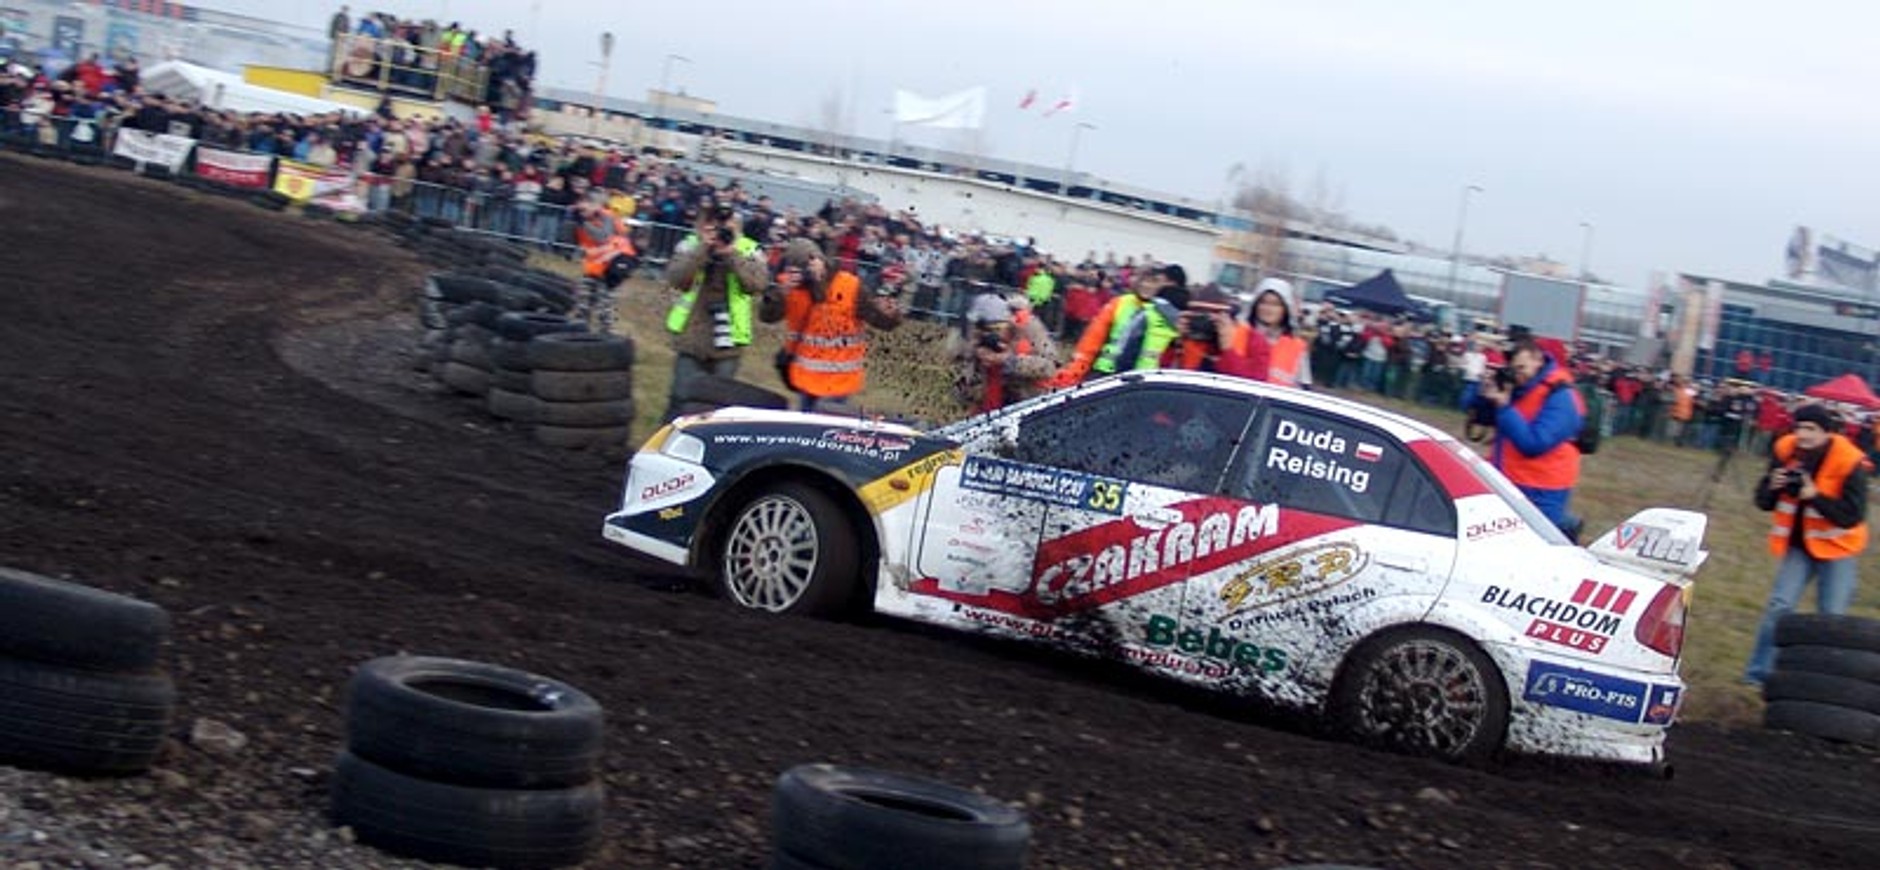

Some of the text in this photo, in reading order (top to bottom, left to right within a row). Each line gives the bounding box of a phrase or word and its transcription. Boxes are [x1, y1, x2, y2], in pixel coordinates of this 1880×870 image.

[1276, 420, 1346, 454] Duda
[1266, 447, 1370, 492] Reising
[1035, 502, 1280, 606] CZAKRAM
[1481, 585, 1622, 637] BLACHDOM
[1147, 613, 1289, 672] Bebes
[1532, 621, 1605, 652] PLUS
[1562, 680, 1638, 709] PRO-FIS
